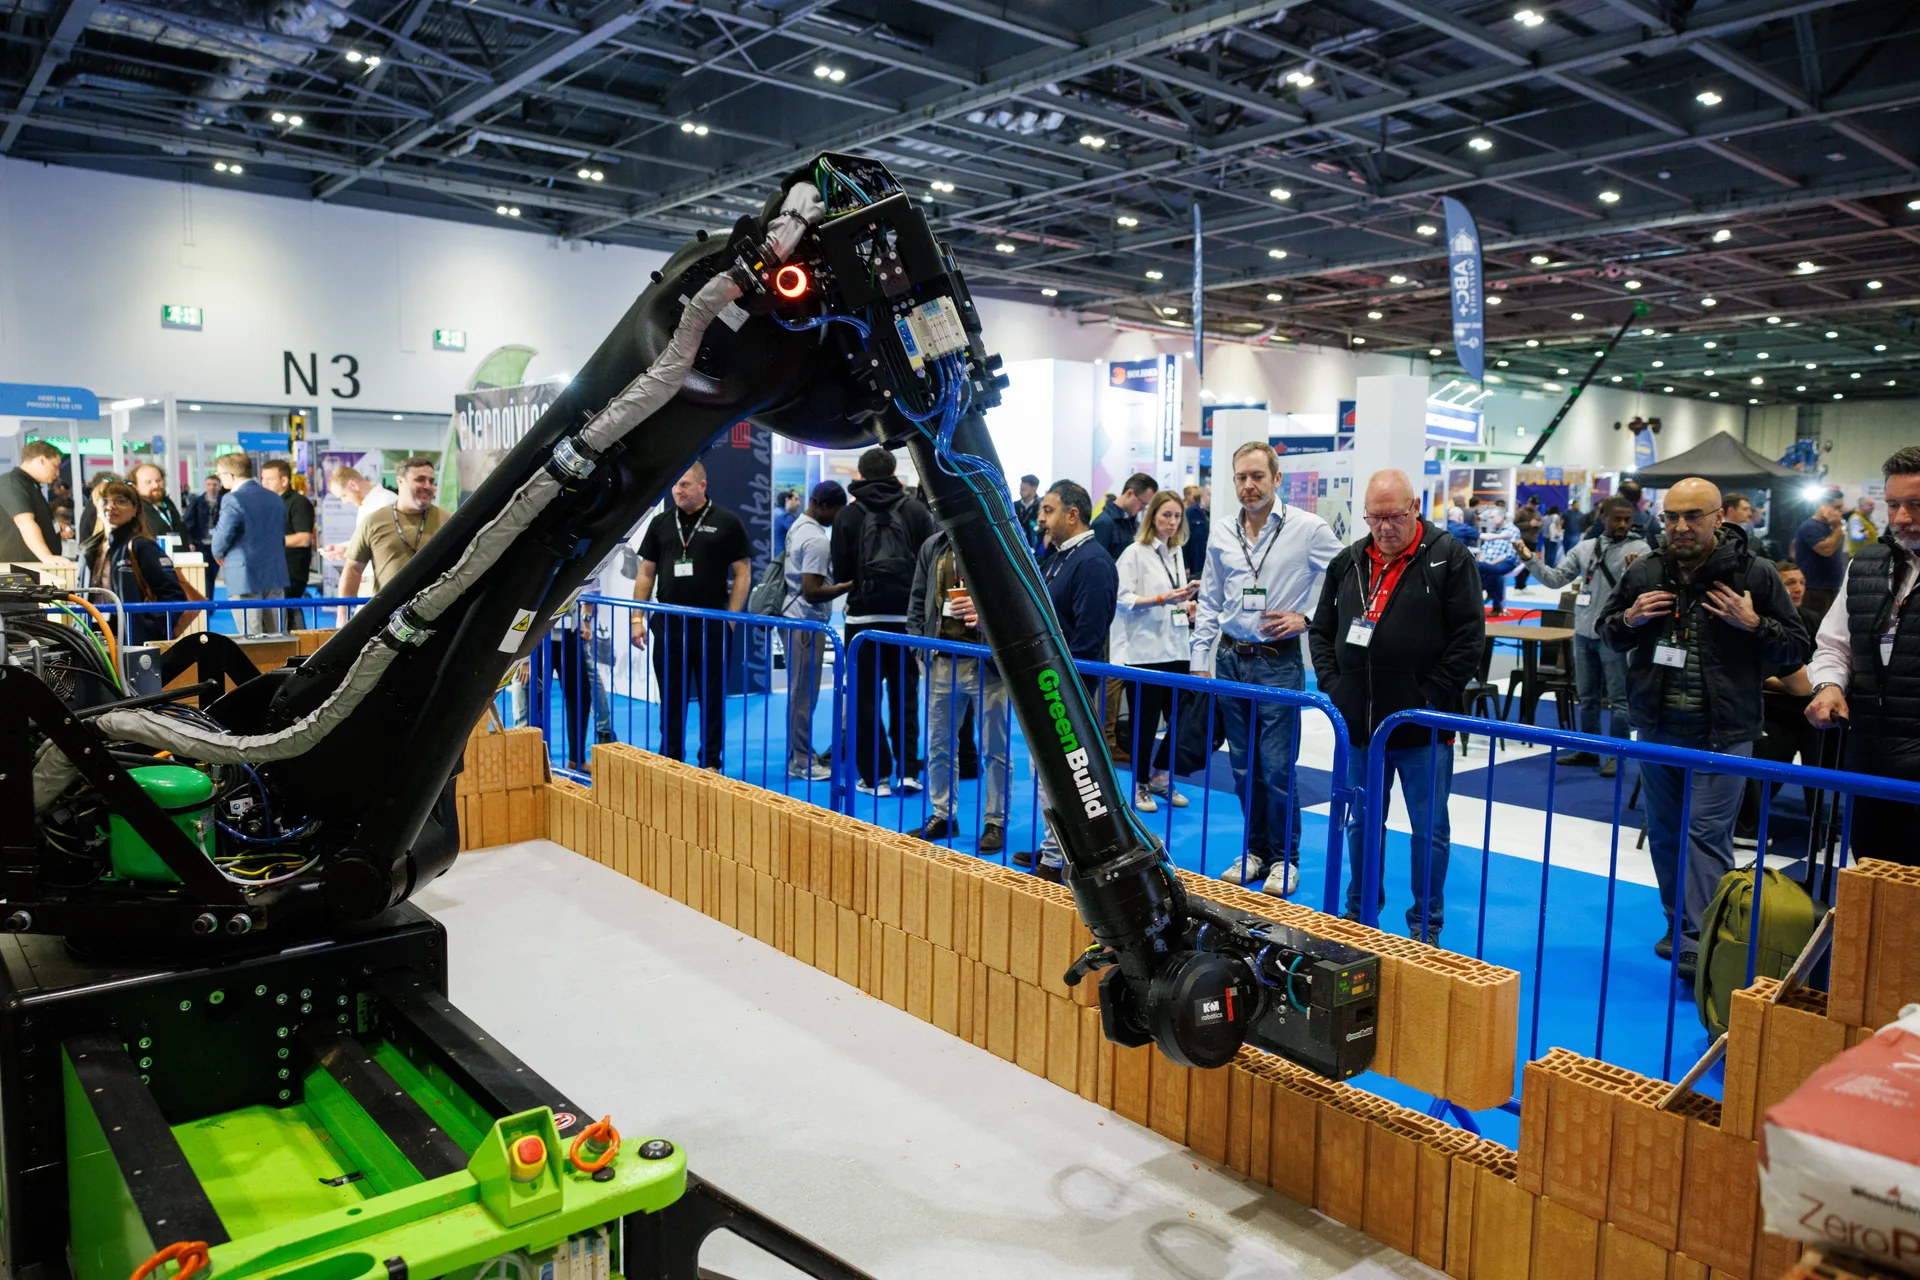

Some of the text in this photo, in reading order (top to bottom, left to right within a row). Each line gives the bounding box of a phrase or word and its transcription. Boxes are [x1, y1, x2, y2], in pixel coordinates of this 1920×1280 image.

[284, 351, 360, 399] N 3
[740, 473, 771, 531] step
[1037, 668, 1108, 820] GreenBuild
[1201, 1012, 1223, 1021] robotics
[1346, 1026, 1374, 1042] GreenBuild
